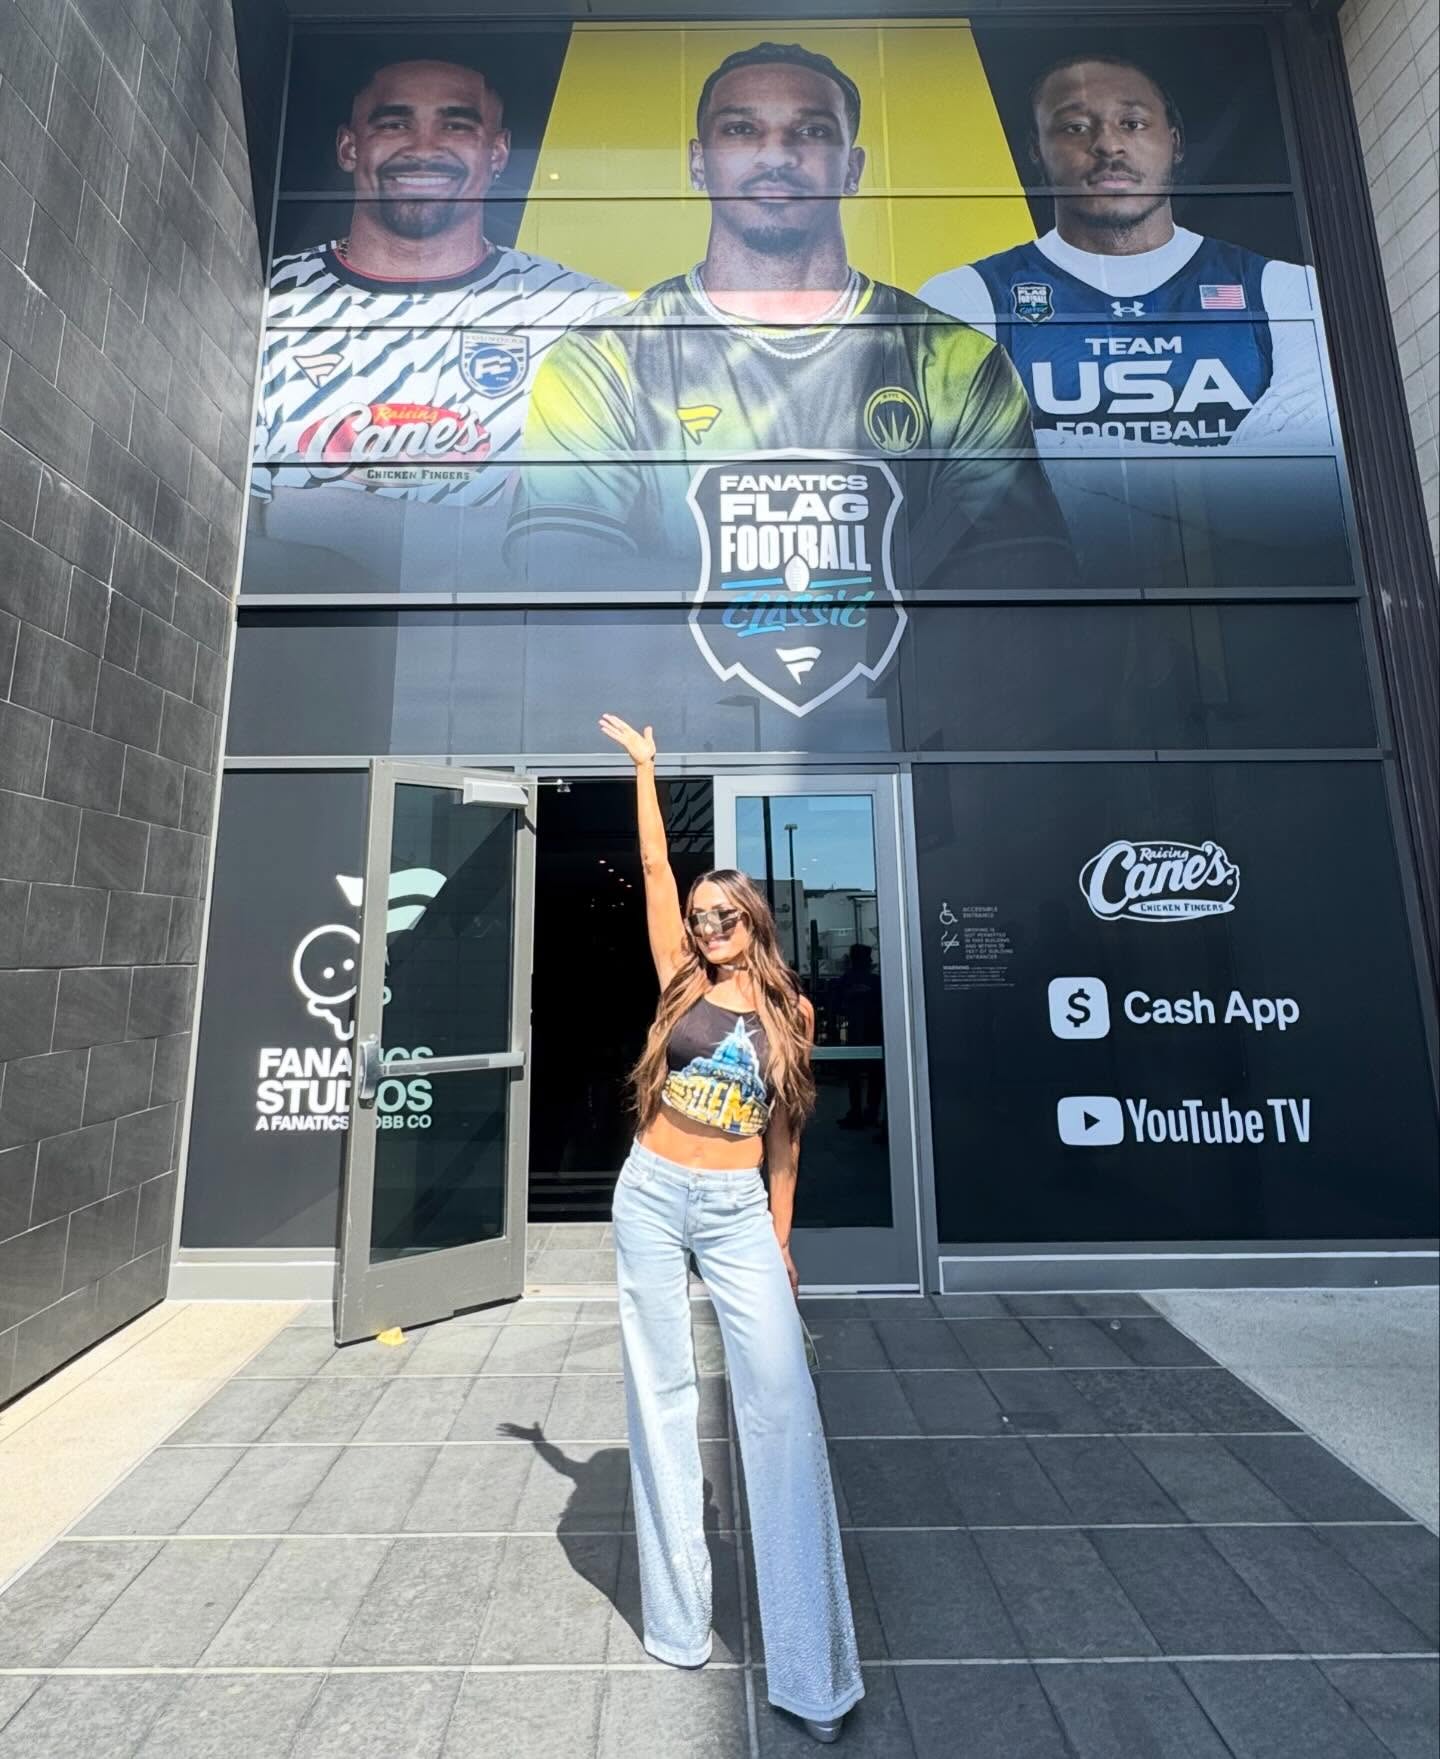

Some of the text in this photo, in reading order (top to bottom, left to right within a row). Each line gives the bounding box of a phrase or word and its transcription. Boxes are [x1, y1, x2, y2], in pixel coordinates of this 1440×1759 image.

[1084, 336, 1182, 355] TEAM
[1031, 358, 1254, 415] USA
[374, 405, 438, 423] Raising
[304, 402, 490, 479] Cane's
[1056, 419, 1235, 440] FOOTBALL
[366, 469, 470, 480] CHICKEN FINGERS
[720, 475, 868, 491] FANATICS
[720, 493, 869, 522] FLAG
[720, 525, 872, 573] FOOTBALL
[1139, 847, 1189, 861] Raising
[1090, 842, 1235, 914] Cane's
[1140, 903, 1224, 912] CHICKEN FINGERS
[1066, 988, 1300, 1031] $ Cash App
[258, 1046, 434, 1078] FANACS
[256, 1078, 433, 1114] STUOS
[256, 1115, 269, 1131] A
[270, 1115, 349, 1131] FANATICS
[407, 1114, 432, 1128] CO
[1125, 1098, 1311, 1144] YouTube TV
